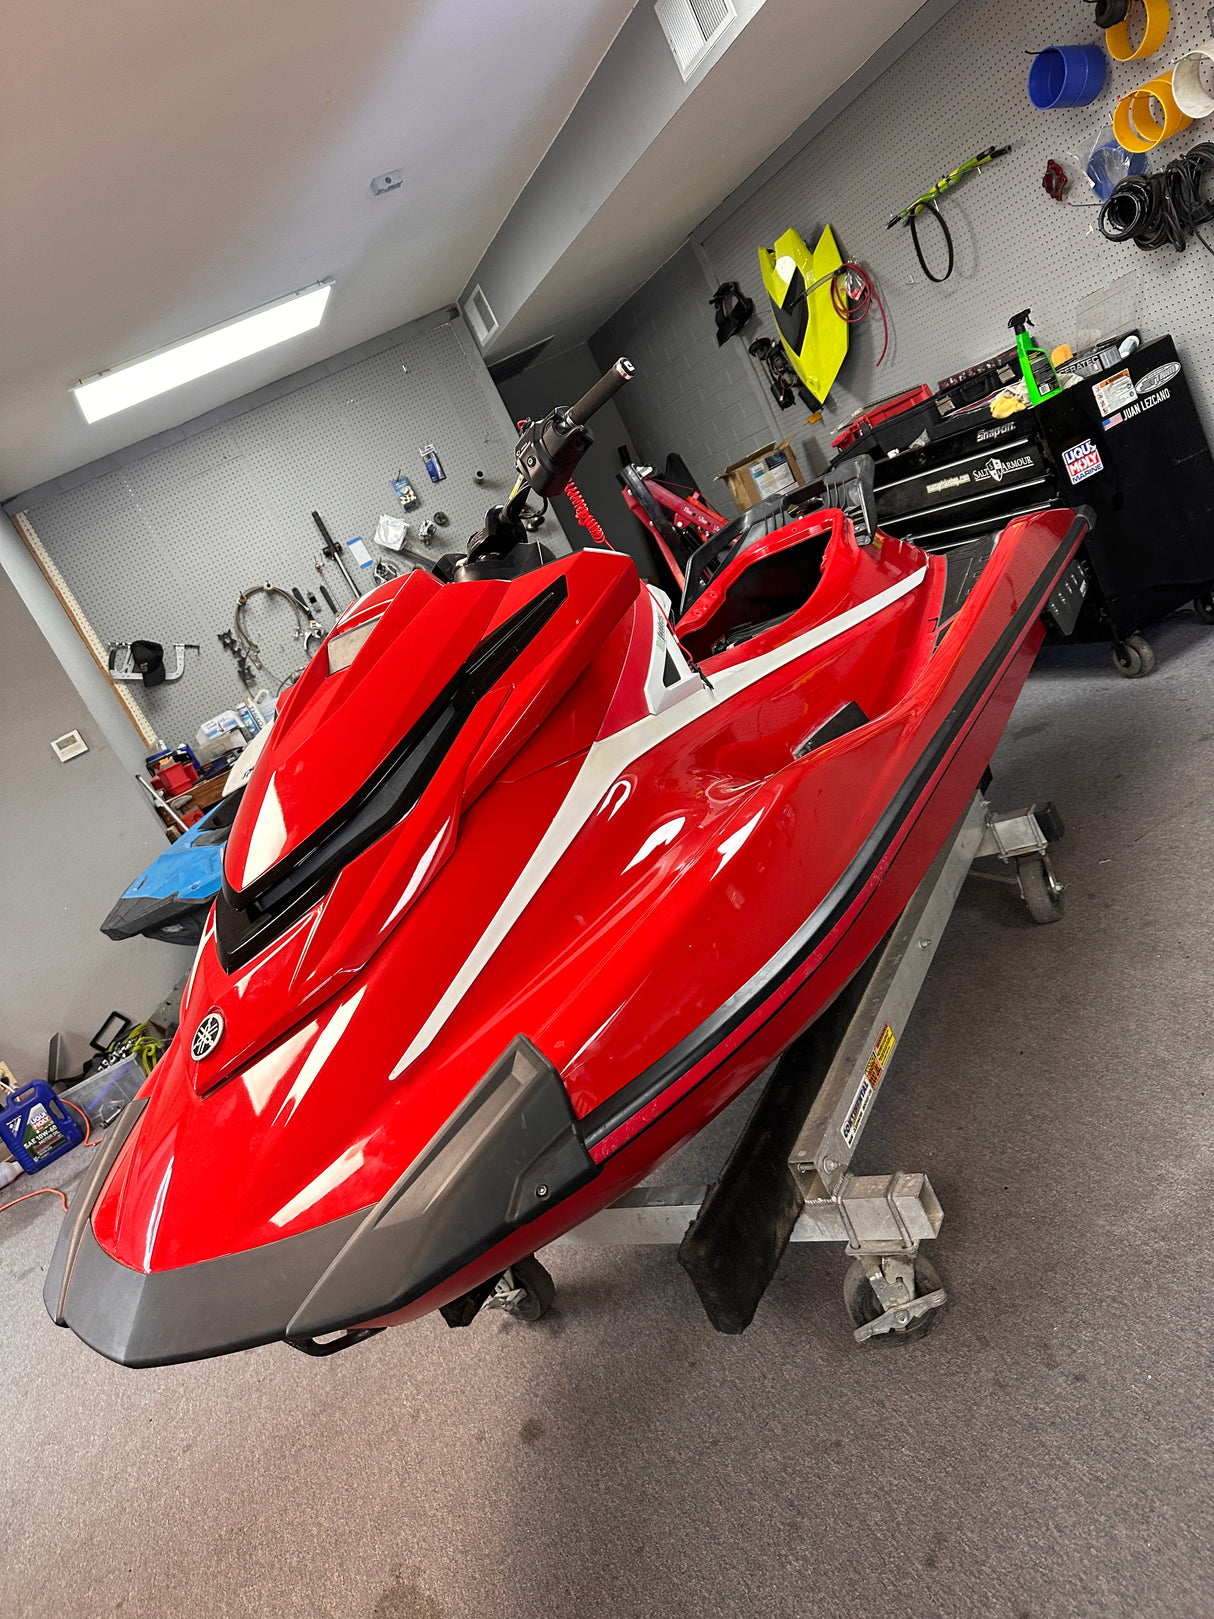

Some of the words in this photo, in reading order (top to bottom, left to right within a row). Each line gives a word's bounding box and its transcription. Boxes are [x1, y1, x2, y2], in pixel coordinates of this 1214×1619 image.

[1058, 355, 1100, 375] CERATEC
[1123, 403, 1142, 421] JUAN
[1140, 387, 1171, 411] LEZCANO
[1069, 453, 1099, 476] MOLY
[1072, 464, 1102, 484] MARINE
[30, 1111, 48, 1125] LIQUI
[843, 1080, 869, 1138] CONTINENTAL
[32, 1115, 51, 1130] MOLY
[23, 1138, 37, 1149] SAE
